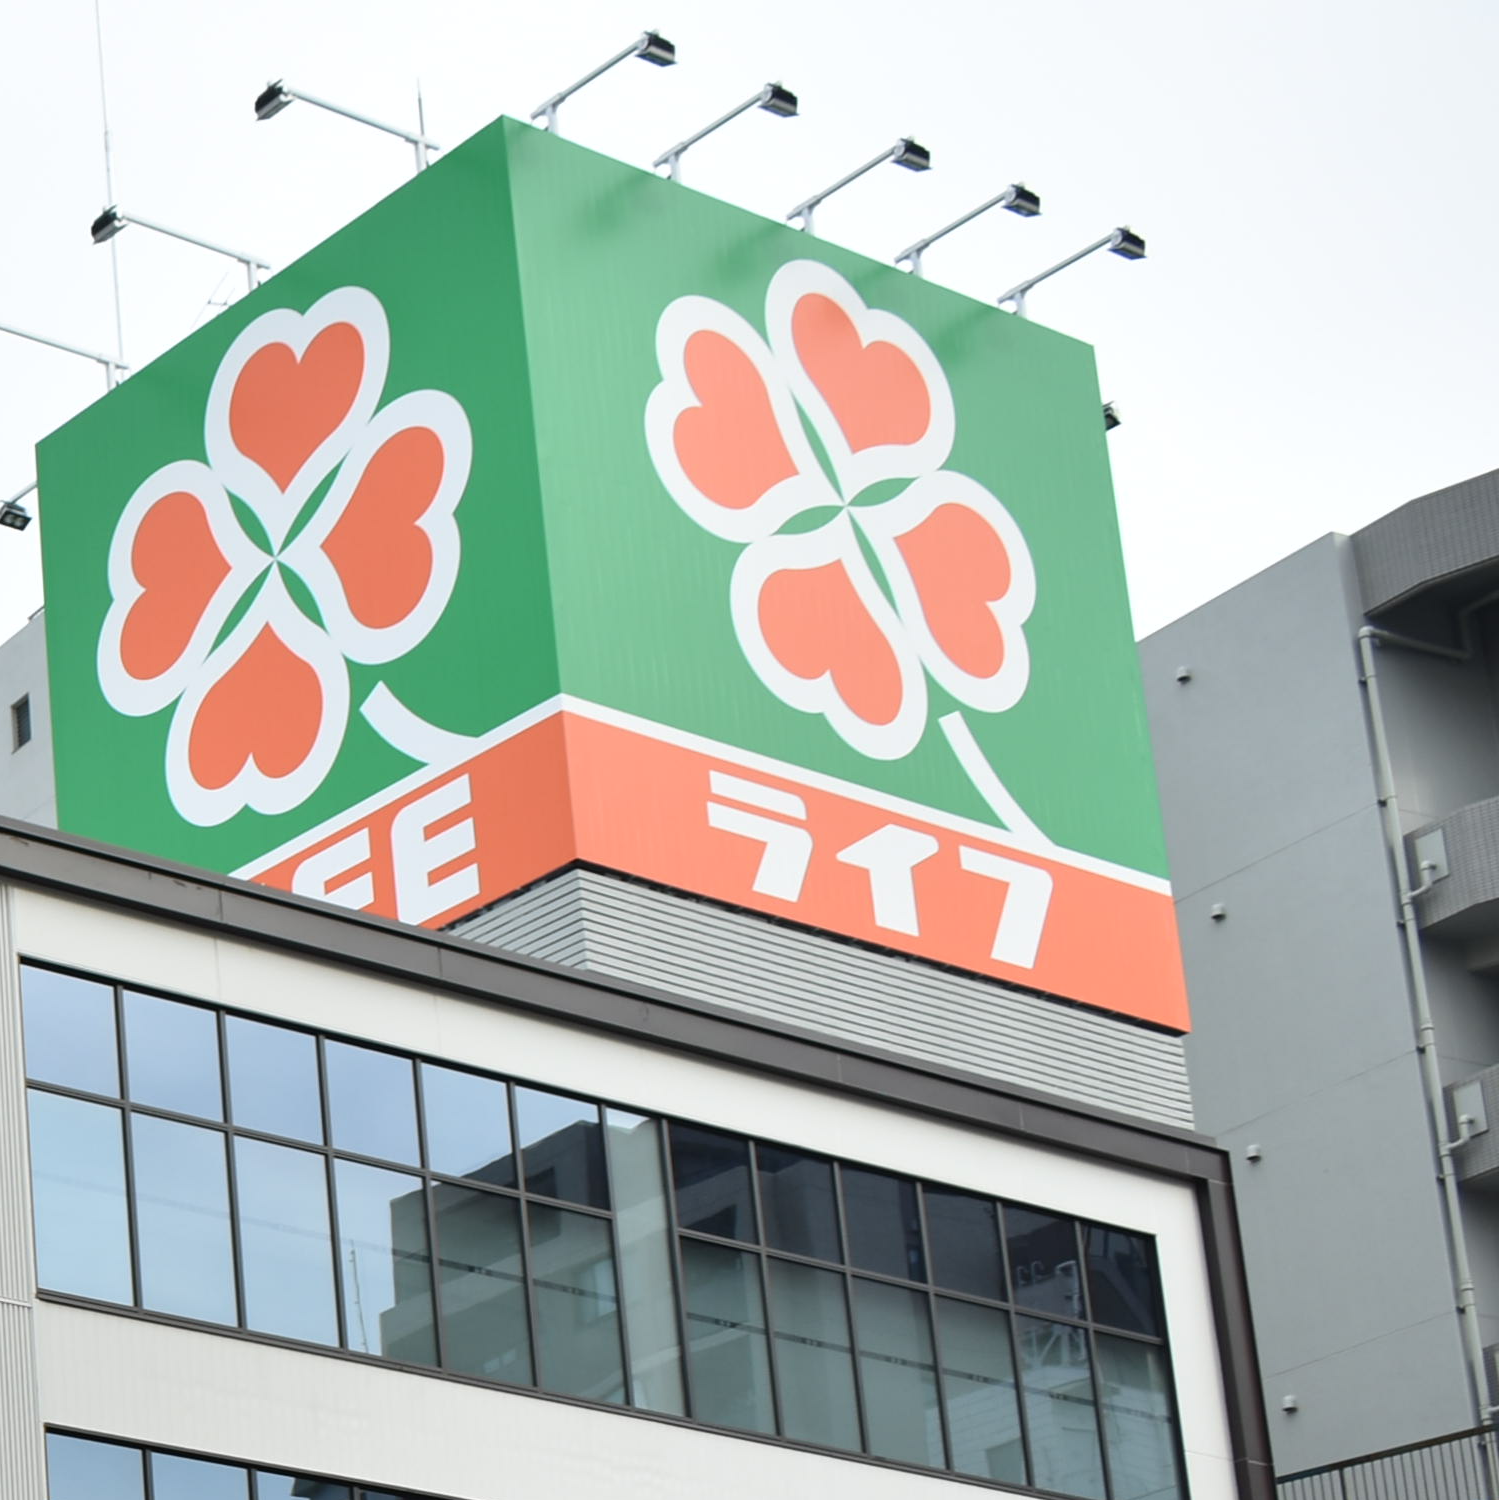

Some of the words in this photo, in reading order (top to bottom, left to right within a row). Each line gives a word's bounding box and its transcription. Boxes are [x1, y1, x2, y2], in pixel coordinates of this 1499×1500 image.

[291, 773, 481, 926] FE
[706, 769, 1054, 970] ライフ
